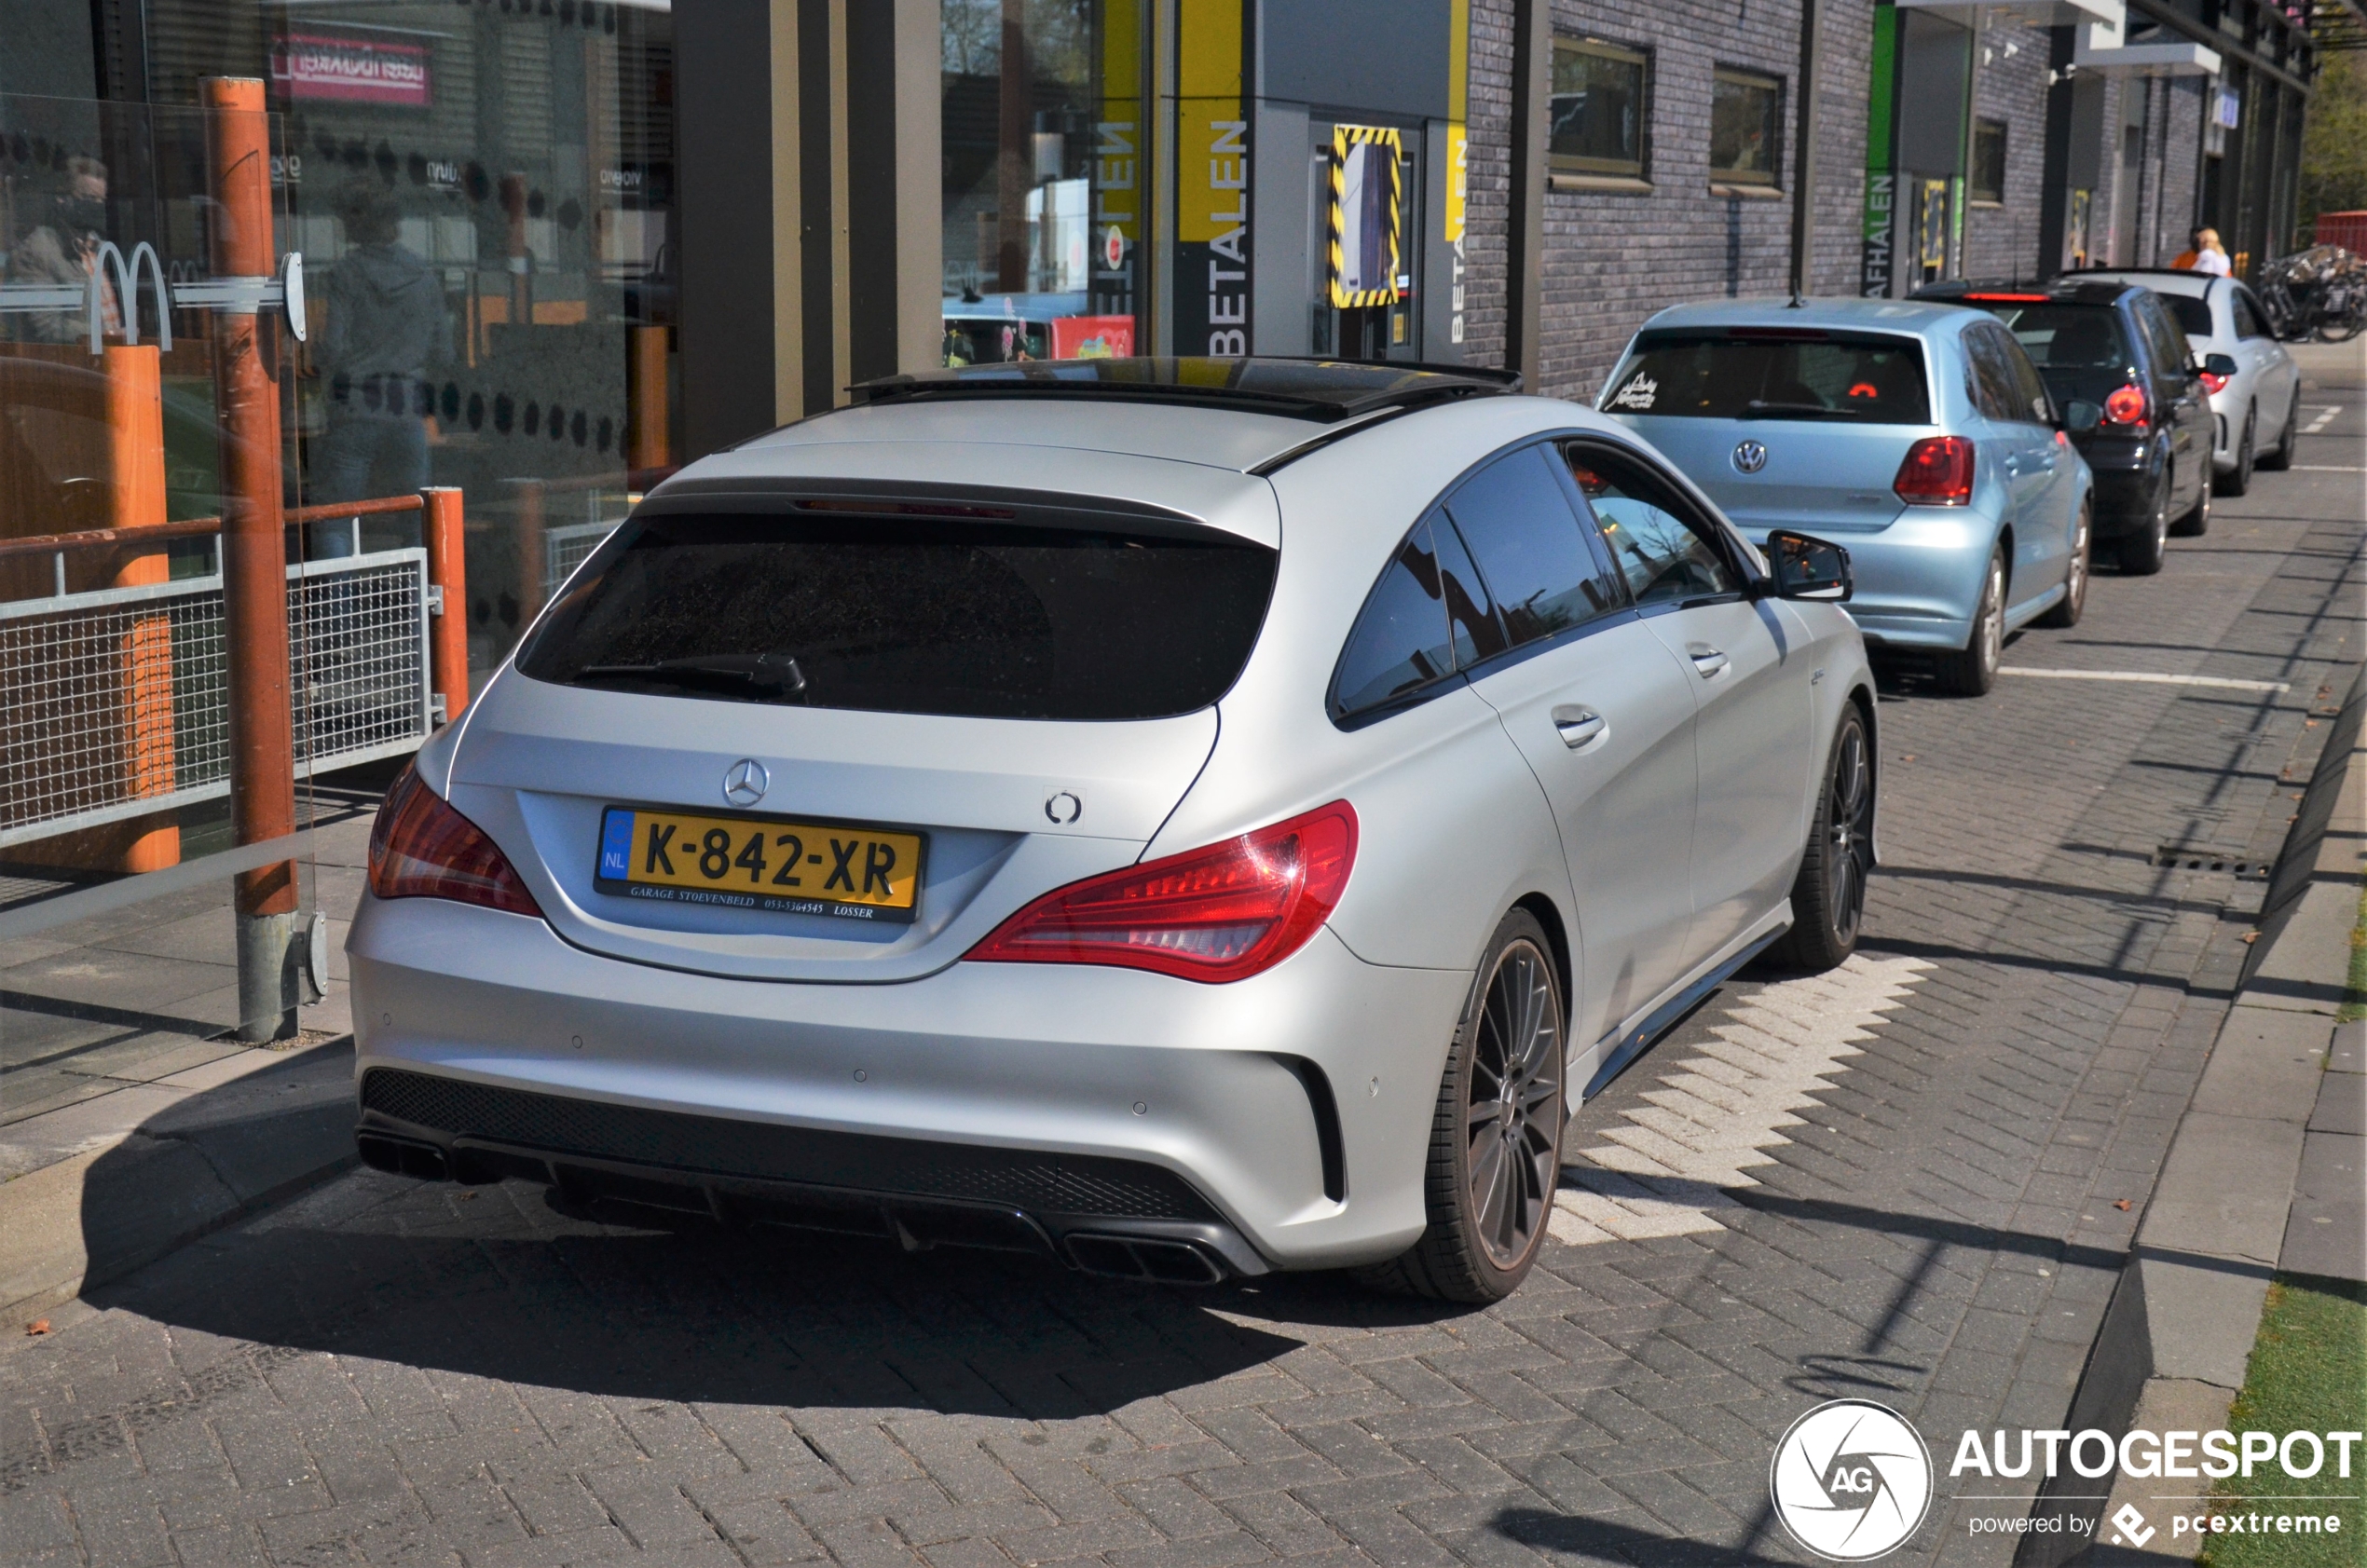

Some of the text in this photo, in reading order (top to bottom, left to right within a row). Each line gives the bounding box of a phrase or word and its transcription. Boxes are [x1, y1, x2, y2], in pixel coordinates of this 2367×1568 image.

[1210, 121, 1247, 357] BETALEN
[1452, 140, 1468, 344] BETALEN
[1866, 175, 1893, 298] AFHALEN
[606, 852, 624, 868] NL
[631, 887, 873, 919] GARAGE STOEVENBELD 053-5364545 LOSSER
[646, 824, 896, 894] K-842-XR
